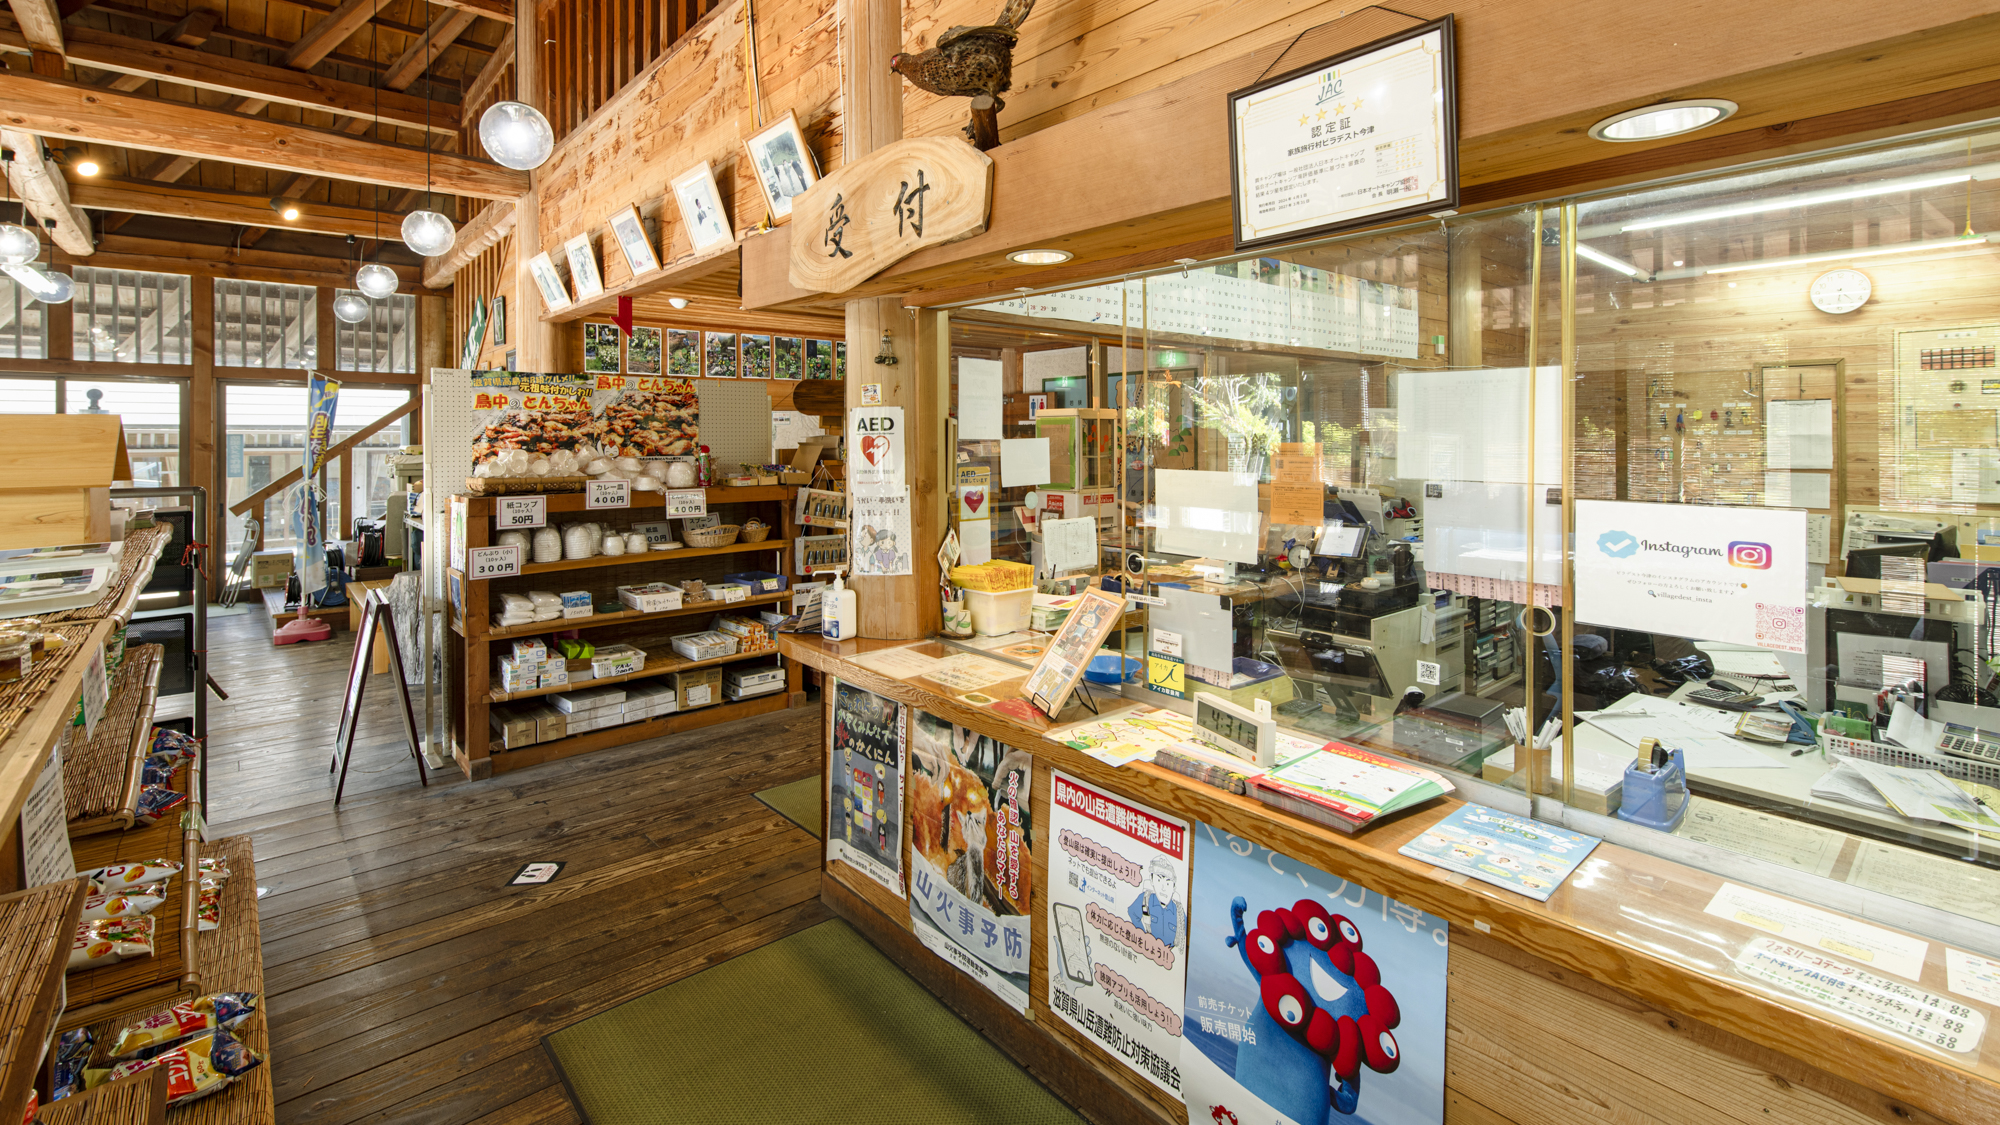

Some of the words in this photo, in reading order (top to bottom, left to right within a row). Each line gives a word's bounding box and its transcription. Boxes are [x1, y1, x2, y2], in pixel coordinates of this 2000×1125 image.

[1318, 79, 1344, 101] JAC
[1287, 125, 1375, 156] 家族旅行村ビラデスト今津
[1311, 117, 1351, 138] 認定証
[824, 169, 930, 259] 受付
[519, 383, 593, 397] 元祖味付かしわ!!
[857, 417, 894, 431] AED
[507, 500, 538, 509] 紙コップ
[512, 515, 533, 524] 50円
[1641, 539, 1723, 558] Instagram
[479, 563, 514, 573] 300円
[1657, 592, 1713, 604] villagedest_insta
[1757, 642, 1803, 652] VILLAGEDEST_INSTA
[838, 709, 892, 745] かぞくみんなで
[1212, 709, 1242, 741] 4:31
[835, 719, 894, 766] 火のかくにん
[1008, 770, 1018, 826] 火の確認
[1056, 781, 1181, 853] 県内の山岳遭難件数急増!!
[996, 811, 1006, 900] あなたのマナー
[1009, 829, 1018, 900] 山を愛する
[1063, 835, 1136, 880] 登山届は確実に提出しよう!!
[1068, 857, 1117, 890] ネットでも提出できるよ
[916, 869, 1022, 959] 山火事予防
[1090, 909, 1170, 963] 体力に応じた登山をしよう!!
[1099, 934, 1137, 964] 無理のない計画で
[1754, 952, 1846, 990] オートキャンプAC付き
[1766, 939, 1854, 976] ファミリーコテージ
[1100, 971, 1173, 1027] 読図アプリも活用しよう!!
[1197, 995, 1252, 1019] 前売チケット
[1053, 986, 1180, 1092] 滋賀県山岳遭難防止対策協議会
[1200, 1016, 1257, 1045] 販売開始
